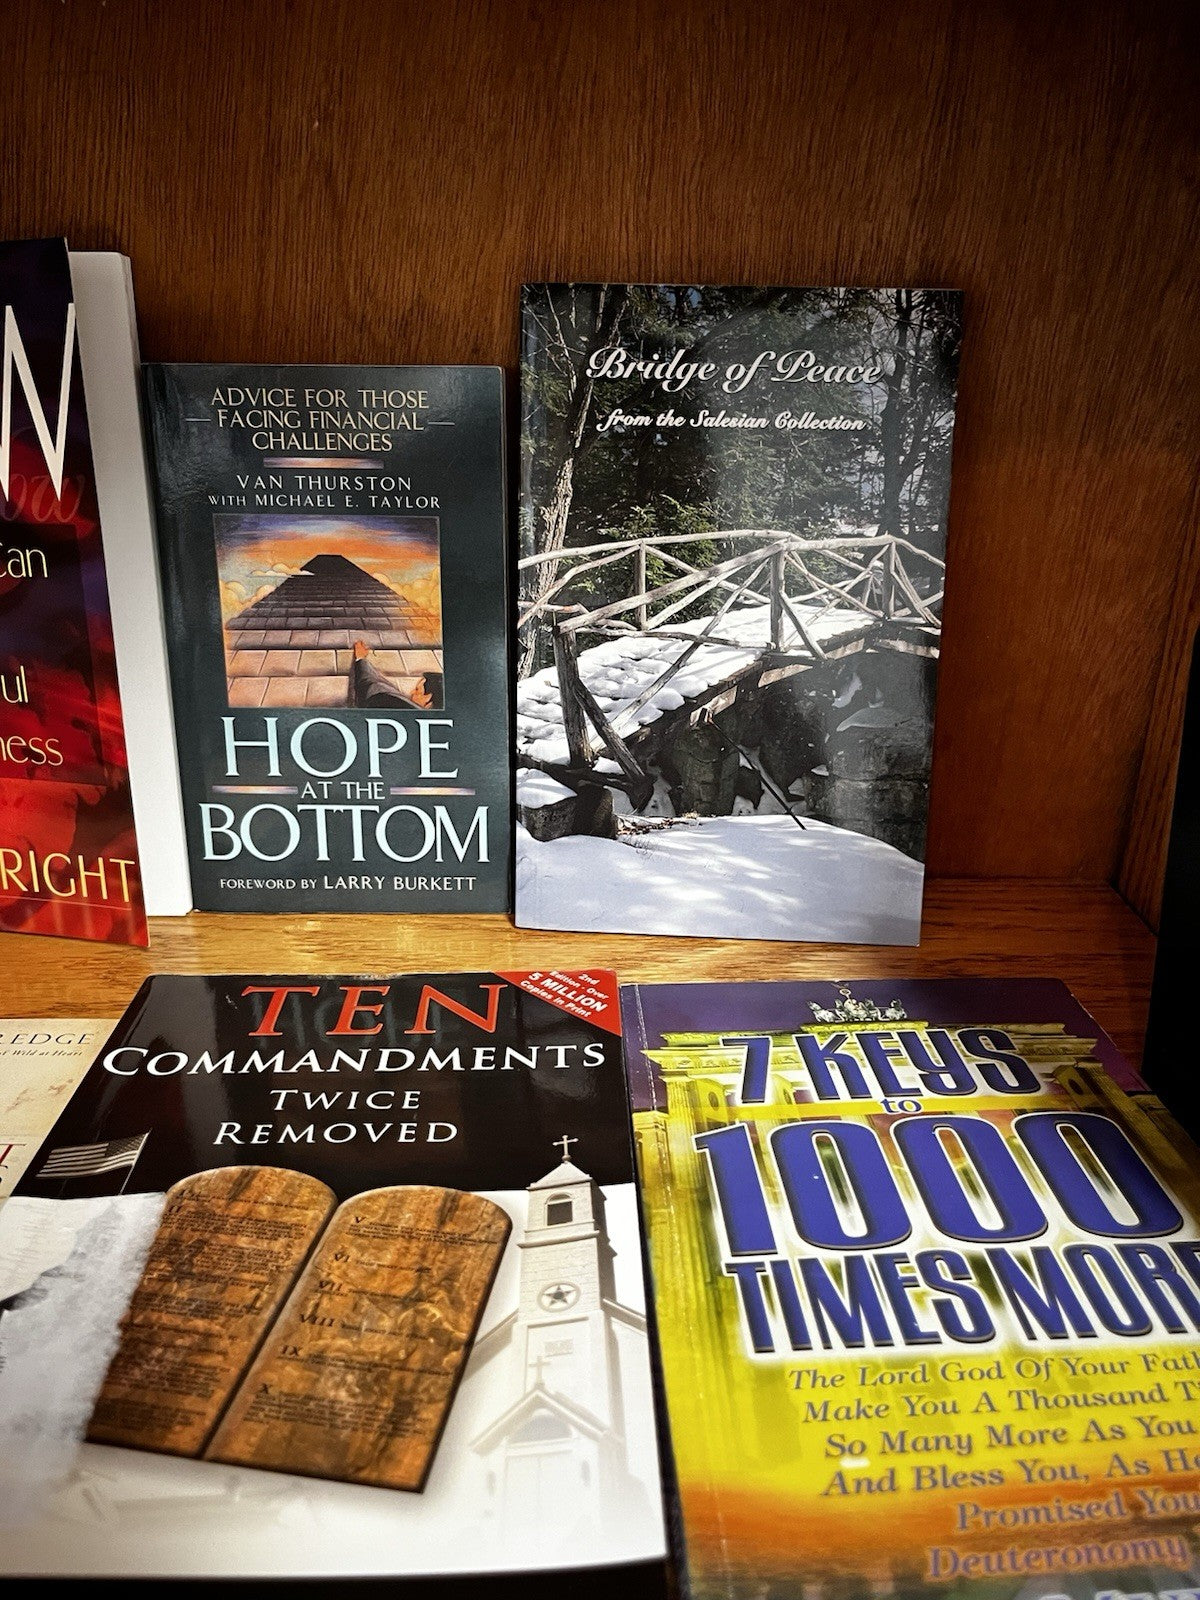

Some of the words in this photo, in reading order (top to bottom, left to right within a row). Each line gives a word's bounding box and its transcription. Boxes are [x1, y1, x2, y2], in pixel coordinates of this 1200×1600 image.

[586, 346, 718, 393] Bridge
[725, 350, 778, 393] of
[771, 348, 884, 384] Peace
[211, 387, 297, 408] ADVICE
[304, 389, 349, 409] FOR
[357, 390, 429, 410] THOSE
[217, 410, 301, 429] FACING
[309, 411, 425, 431] FINANCIAL
[596, 408, 654, 433] from
[656, 409, 684, 427] the
[690, 409, 769, 429] Salesian
[774, 412, 866, 431] Collection
[251, 431, 393, 452] CHALLENGES
[208, 495, 247, 507] WITH
[255, 494, 336, 508] MICHAEL
[345, 495, 359, 508] E.
[368, 496, 441, 509] TAYLOR
[235, 475, 283, 490] VAN
[294, 475, 412, 492] THURSTON
[220, 716, 459, 779] HOPE
[301, 781, 333, 799] AT
[341, 781, 386, 800] THE
[198, 803, 490, 863] BOTTOM
[0, 848, 136, 903] RIGHT
[220, 878, 296, 890] FOREWORD
[301, 878, 317, 890] BY
[324, 875, 386, 891] LARRY
[393, 876, 477, 891] BURKETT
[528, 972, 543, 981] 5
[540, 978, 608, 1012] MILLION
[549, 970, 581, 988] Edition
[586, 987, 609, 999] Over
[578, 973, 600, 985] 2nd
[241, 983, 509, 1038] TEN
[520, 980, 554, 999] Copies
[564, 1002, 592, 1017] Print
[102, 1042, 607, 1077] COMMANDMENTS
[722, 1036, 769, 1104] 7
[268, 1089, 422, 1111] TWICE
[880, 1096, 922, 1114] to
[211, 1121, 459, 1146] REMOVED
[695, 1111, 1185, 1256] 1000
[725, 1249, 996, 1354] TIMES
[789, 1368, 845, 1391] The
[858, 1365, 927, 1388] Lord
[940, 1360, 1006, 1383] God
[1015, 1356, 1055, 1380] Of
[1062, 1357, 1131, 1377] Your
[803, 1400, 890, 1423] Make
[904, 1395, 960, 1418] You
[972, 1391, 998, 1414] A
[1008, 1382, 1170, 1412] Thousand
[825, 1433, 867, 1458] So
[880, 1430, 973, 1456] Many
[985, 1424, 1068, 1449] More
[1081, 1418, 1127, 1443] As
[1131, 1414, 1198, 1439] You
[822, 1469, 897, 1497] And
[913, 1465, 1006, 1491] Bless
[1016, 1458, 1090, 1485] You,
[1105, 1452, 1151, 1478] As
[956, 1490, 1127, 1532] Promised
[1135, 1485, 1200, 1515] You
[928, 1536, 1189, 1579] Deuteronomy
